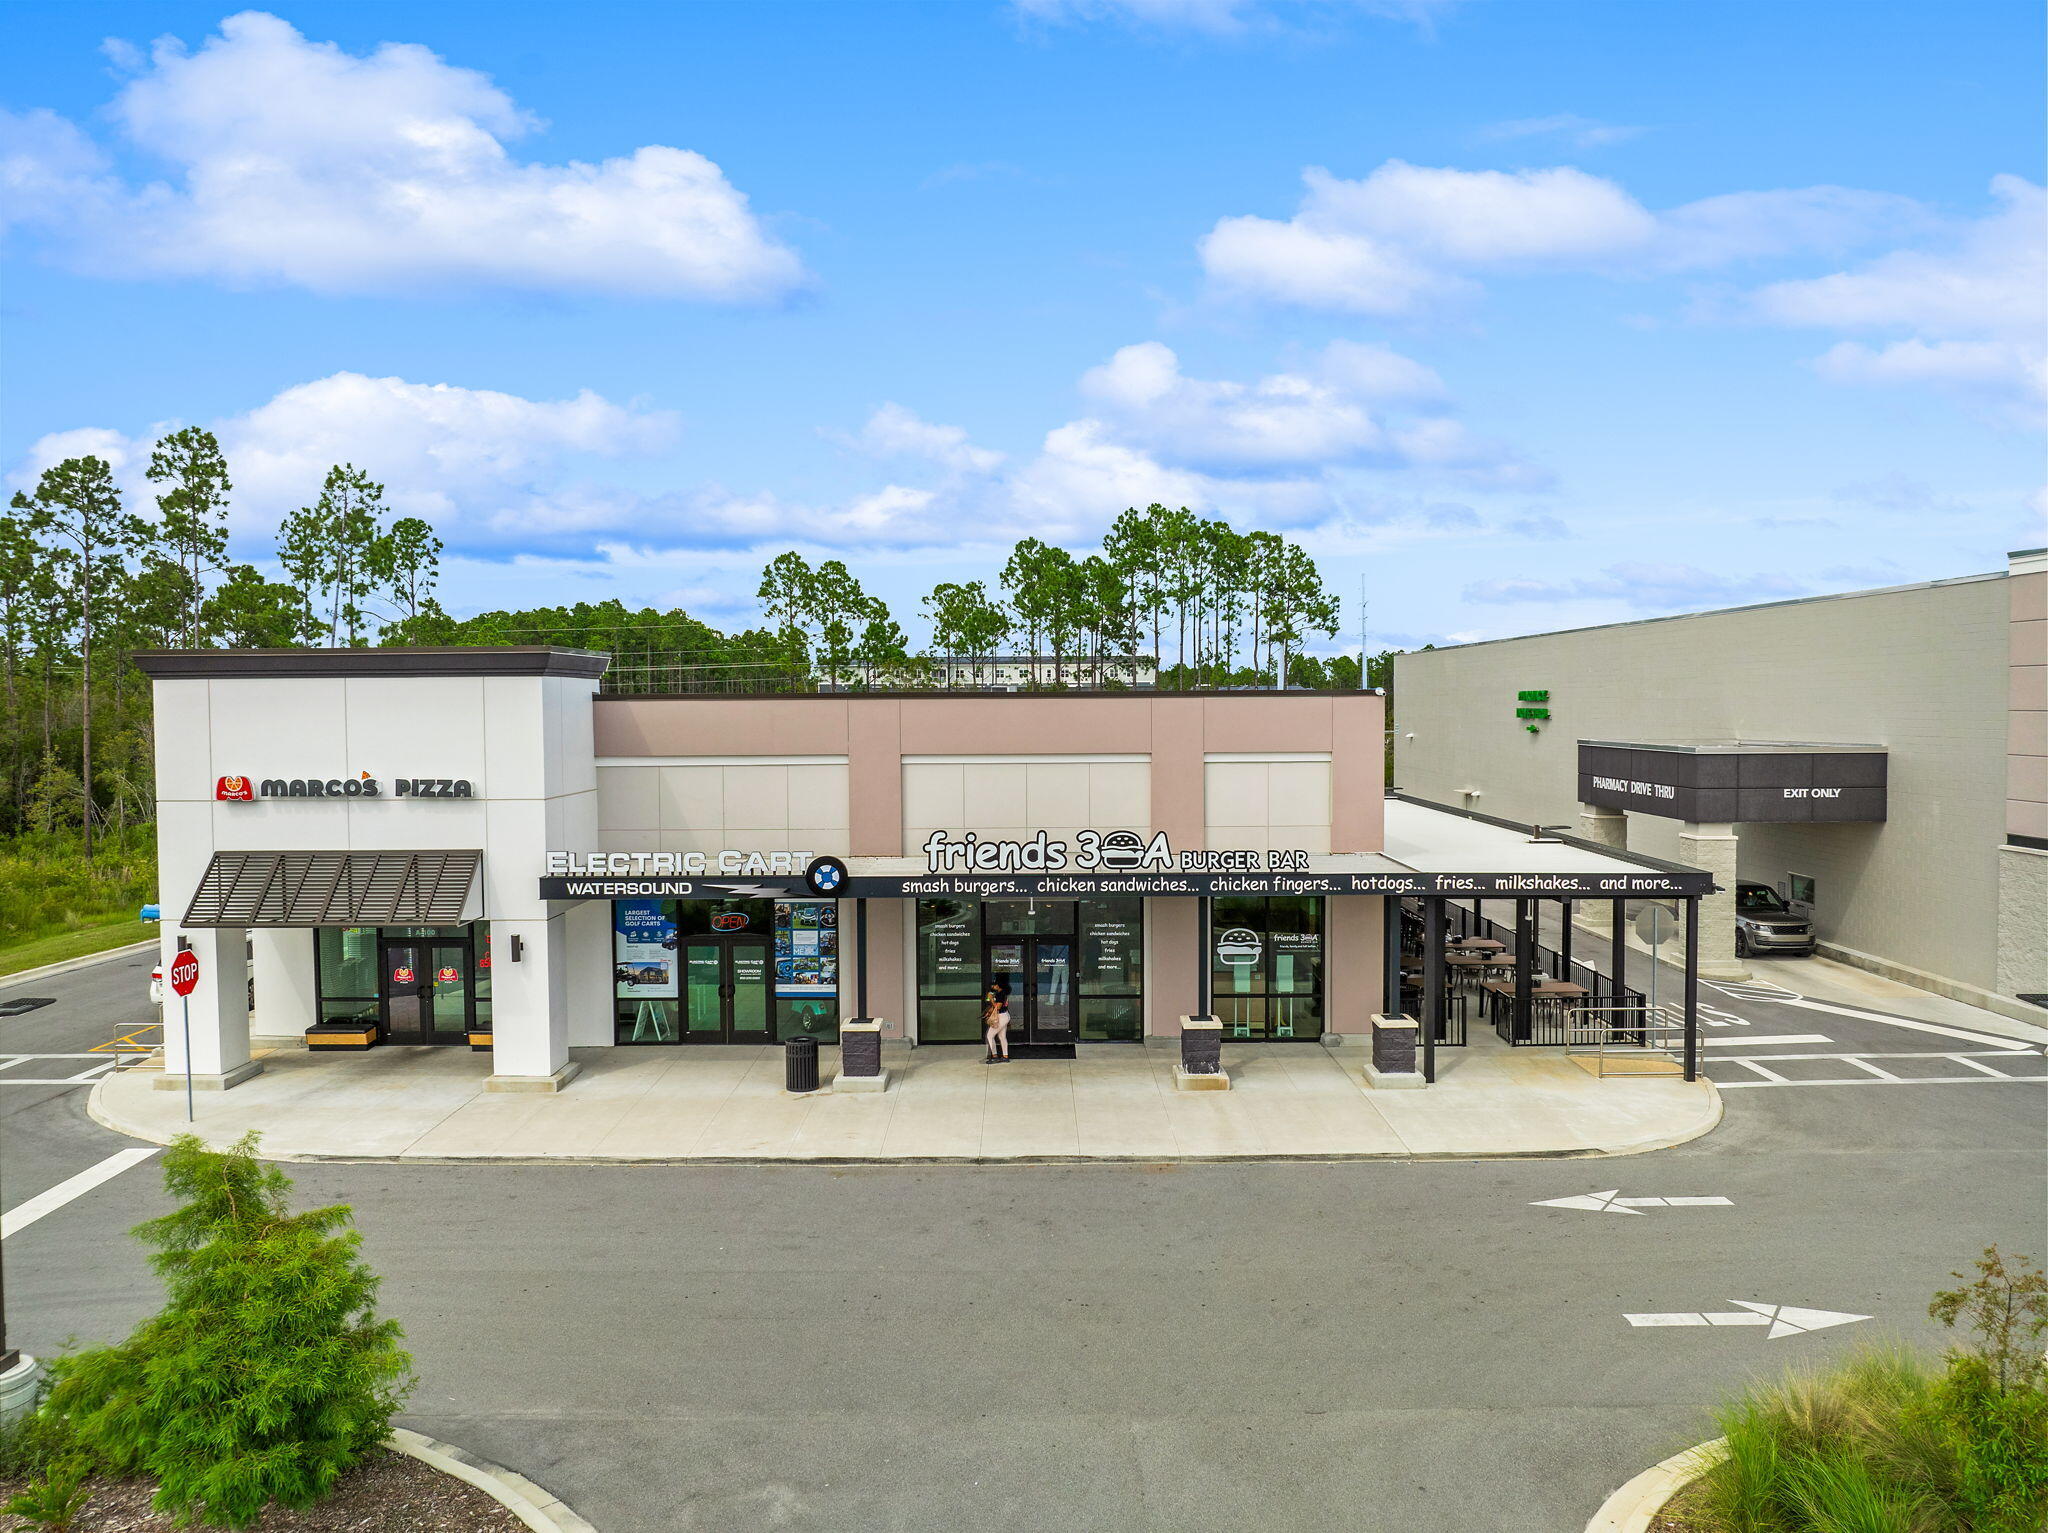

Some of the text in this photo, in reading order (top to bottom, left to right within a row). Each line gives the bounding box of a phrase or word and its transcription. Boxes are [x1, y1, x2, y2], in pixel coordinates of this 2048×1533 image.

[395, 779, 472, 797] PIZZA
[1593, 776, 1675, 799] PHARMACY DRIVE THRU
[1783, 788, 1842, 798] EXIT ONLY
[923, 830, 1067, 872] friends
[1181, 851, 1260, 869] BURGER
[1268, 850, 1309, 869] BAR
[546, 850, 814, 873] ELECTRIC CART
[567, 882, 693, 895] WATERSOUND
[902, 874, 1683, 897] smash burgers... chicken sandwiches... chicken fingers... hotdogs... fries... milkshakes... and more...
[712, 915, 748, 929] OPEN
[1274, 934, 1300, 942] friends
[173, 963, 198, 985] STOP
